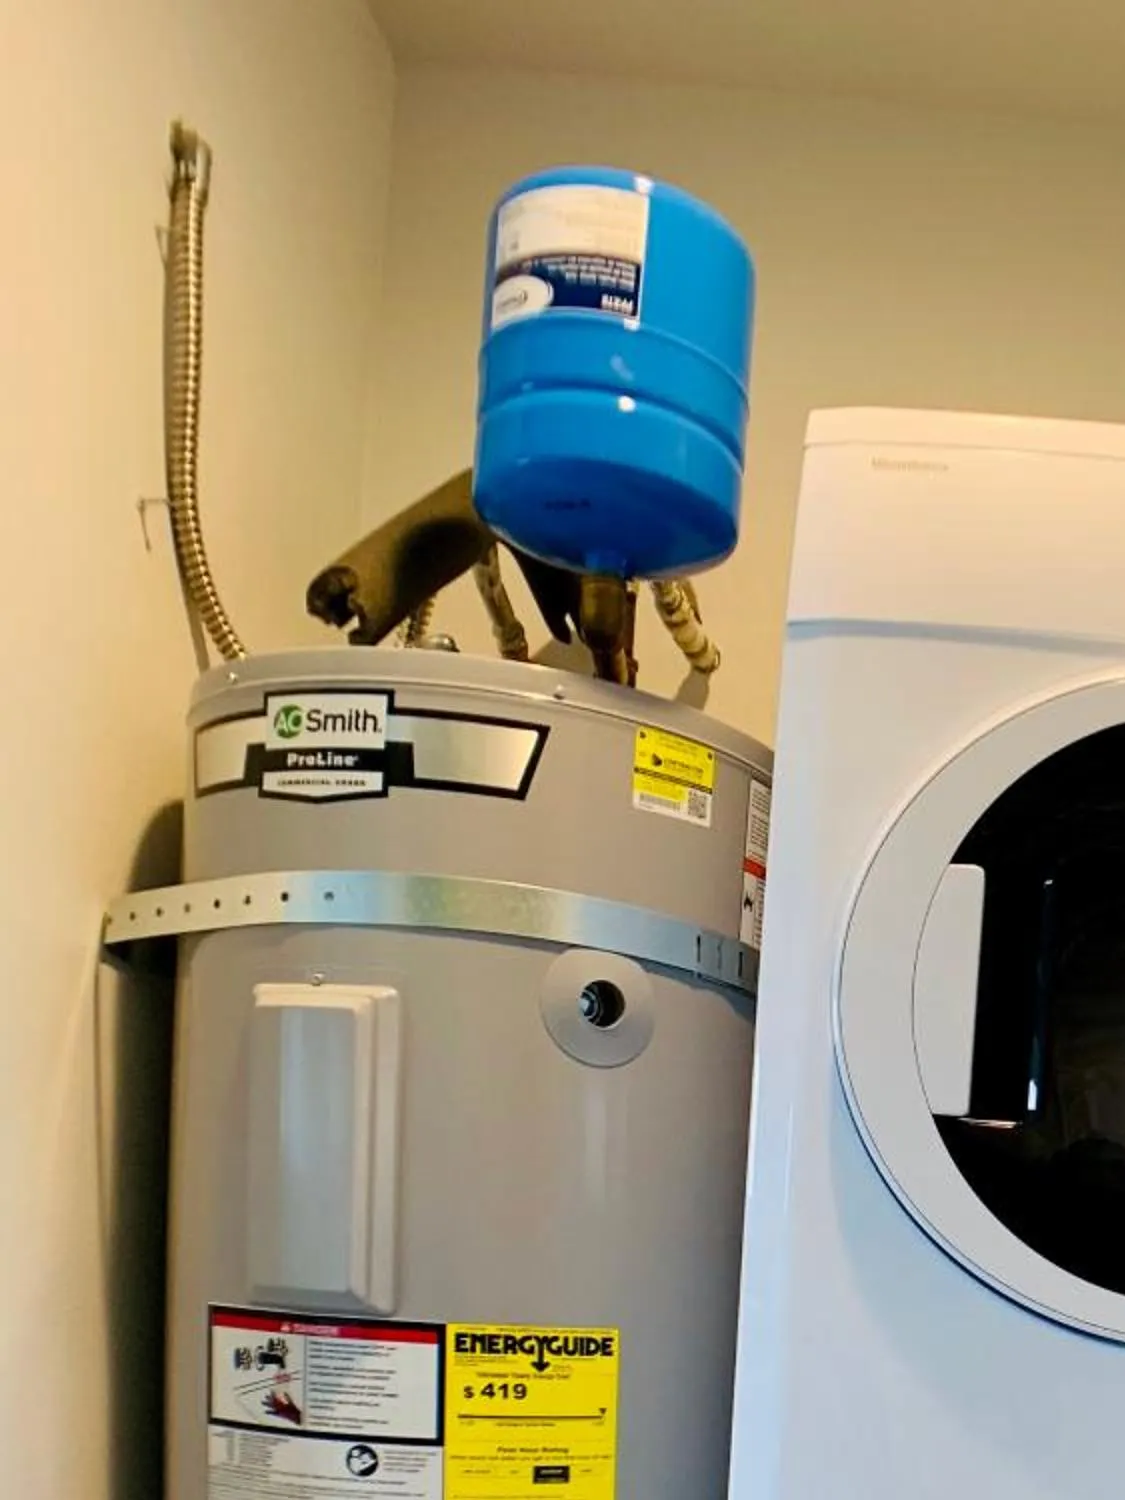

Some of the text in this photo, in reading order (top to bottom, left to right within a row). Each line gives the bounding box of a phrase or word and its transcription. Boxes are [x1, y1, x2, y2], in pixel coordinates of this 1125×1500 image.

[306, 709, 378, 732] Smith
[287, 751, 356, 767] ProLine
[480, 1382, 527, 1400] 419
